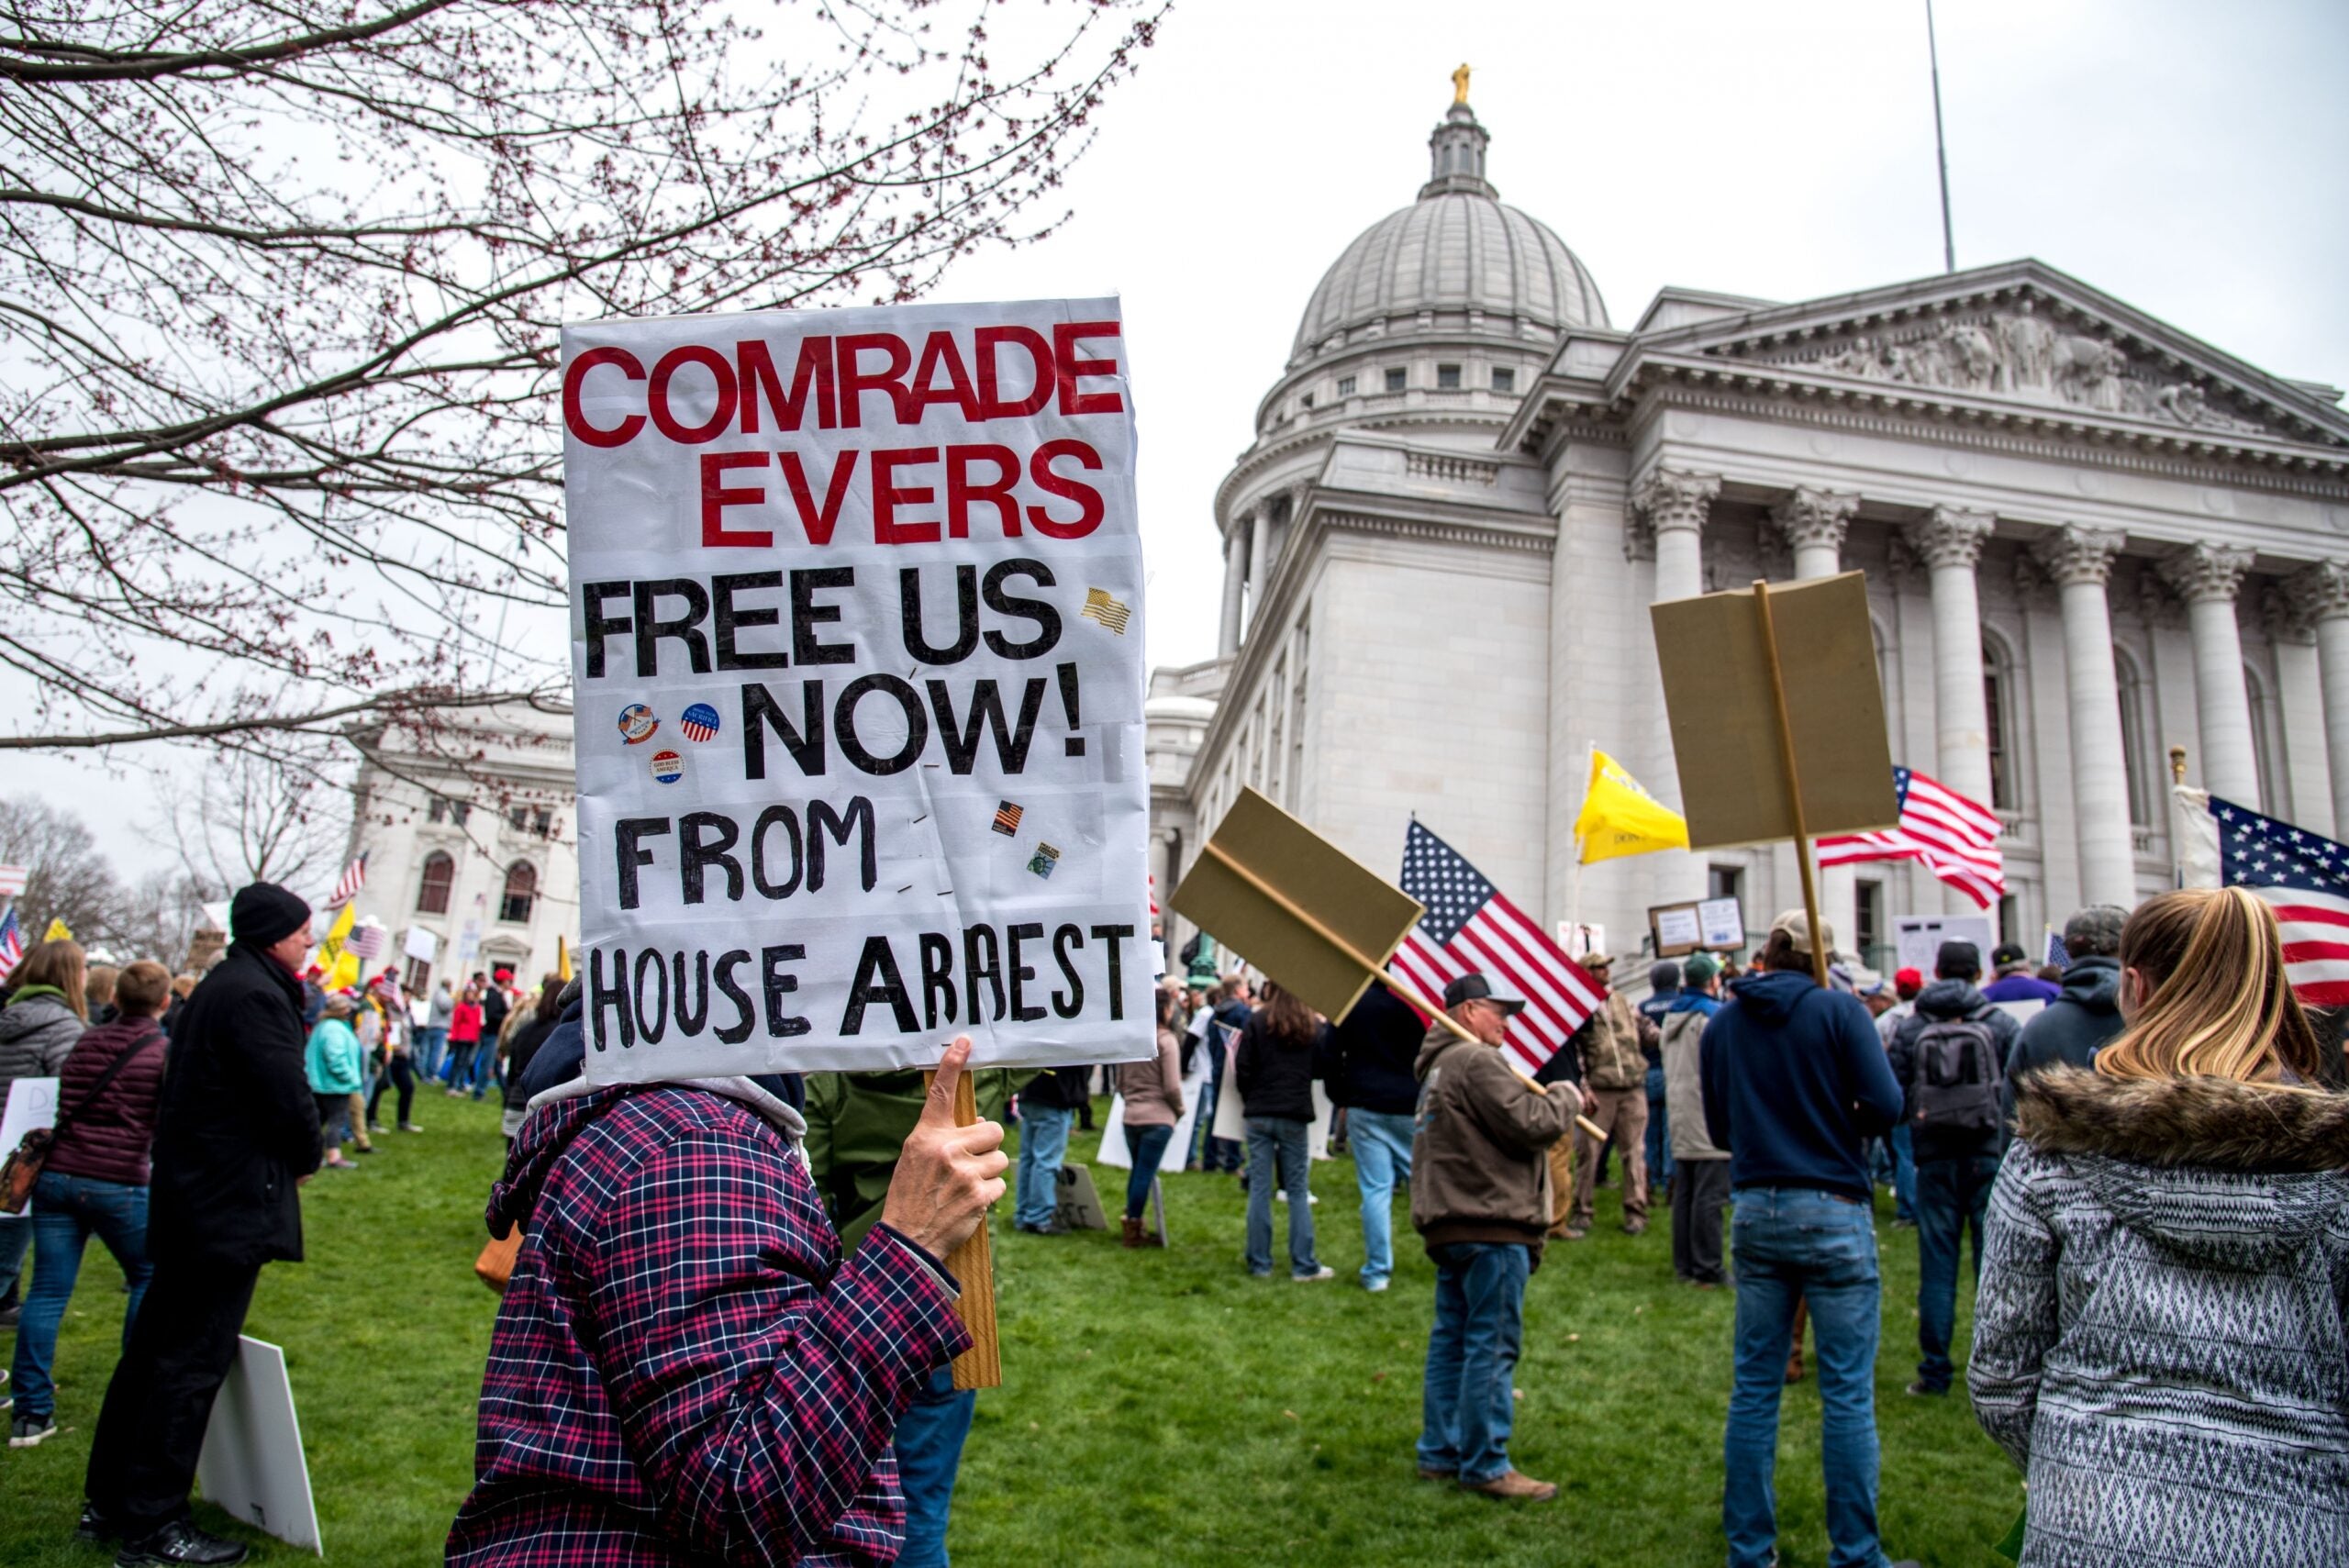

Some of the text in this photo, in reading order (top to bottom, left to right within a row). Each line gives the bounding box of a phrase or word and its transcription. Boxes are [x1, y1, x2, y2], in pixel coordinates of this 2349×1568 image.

[562, 321, 1124, 449] COMRADE
[700, 439, 1105, 548] EVERS
[582, 558, 1063, 679] FREE US
[741, 662, 1086, 780] NOW!
[615, 795, 878, 910] FROM
[589, 923, 1135, 1052] HOUSE ARREST
